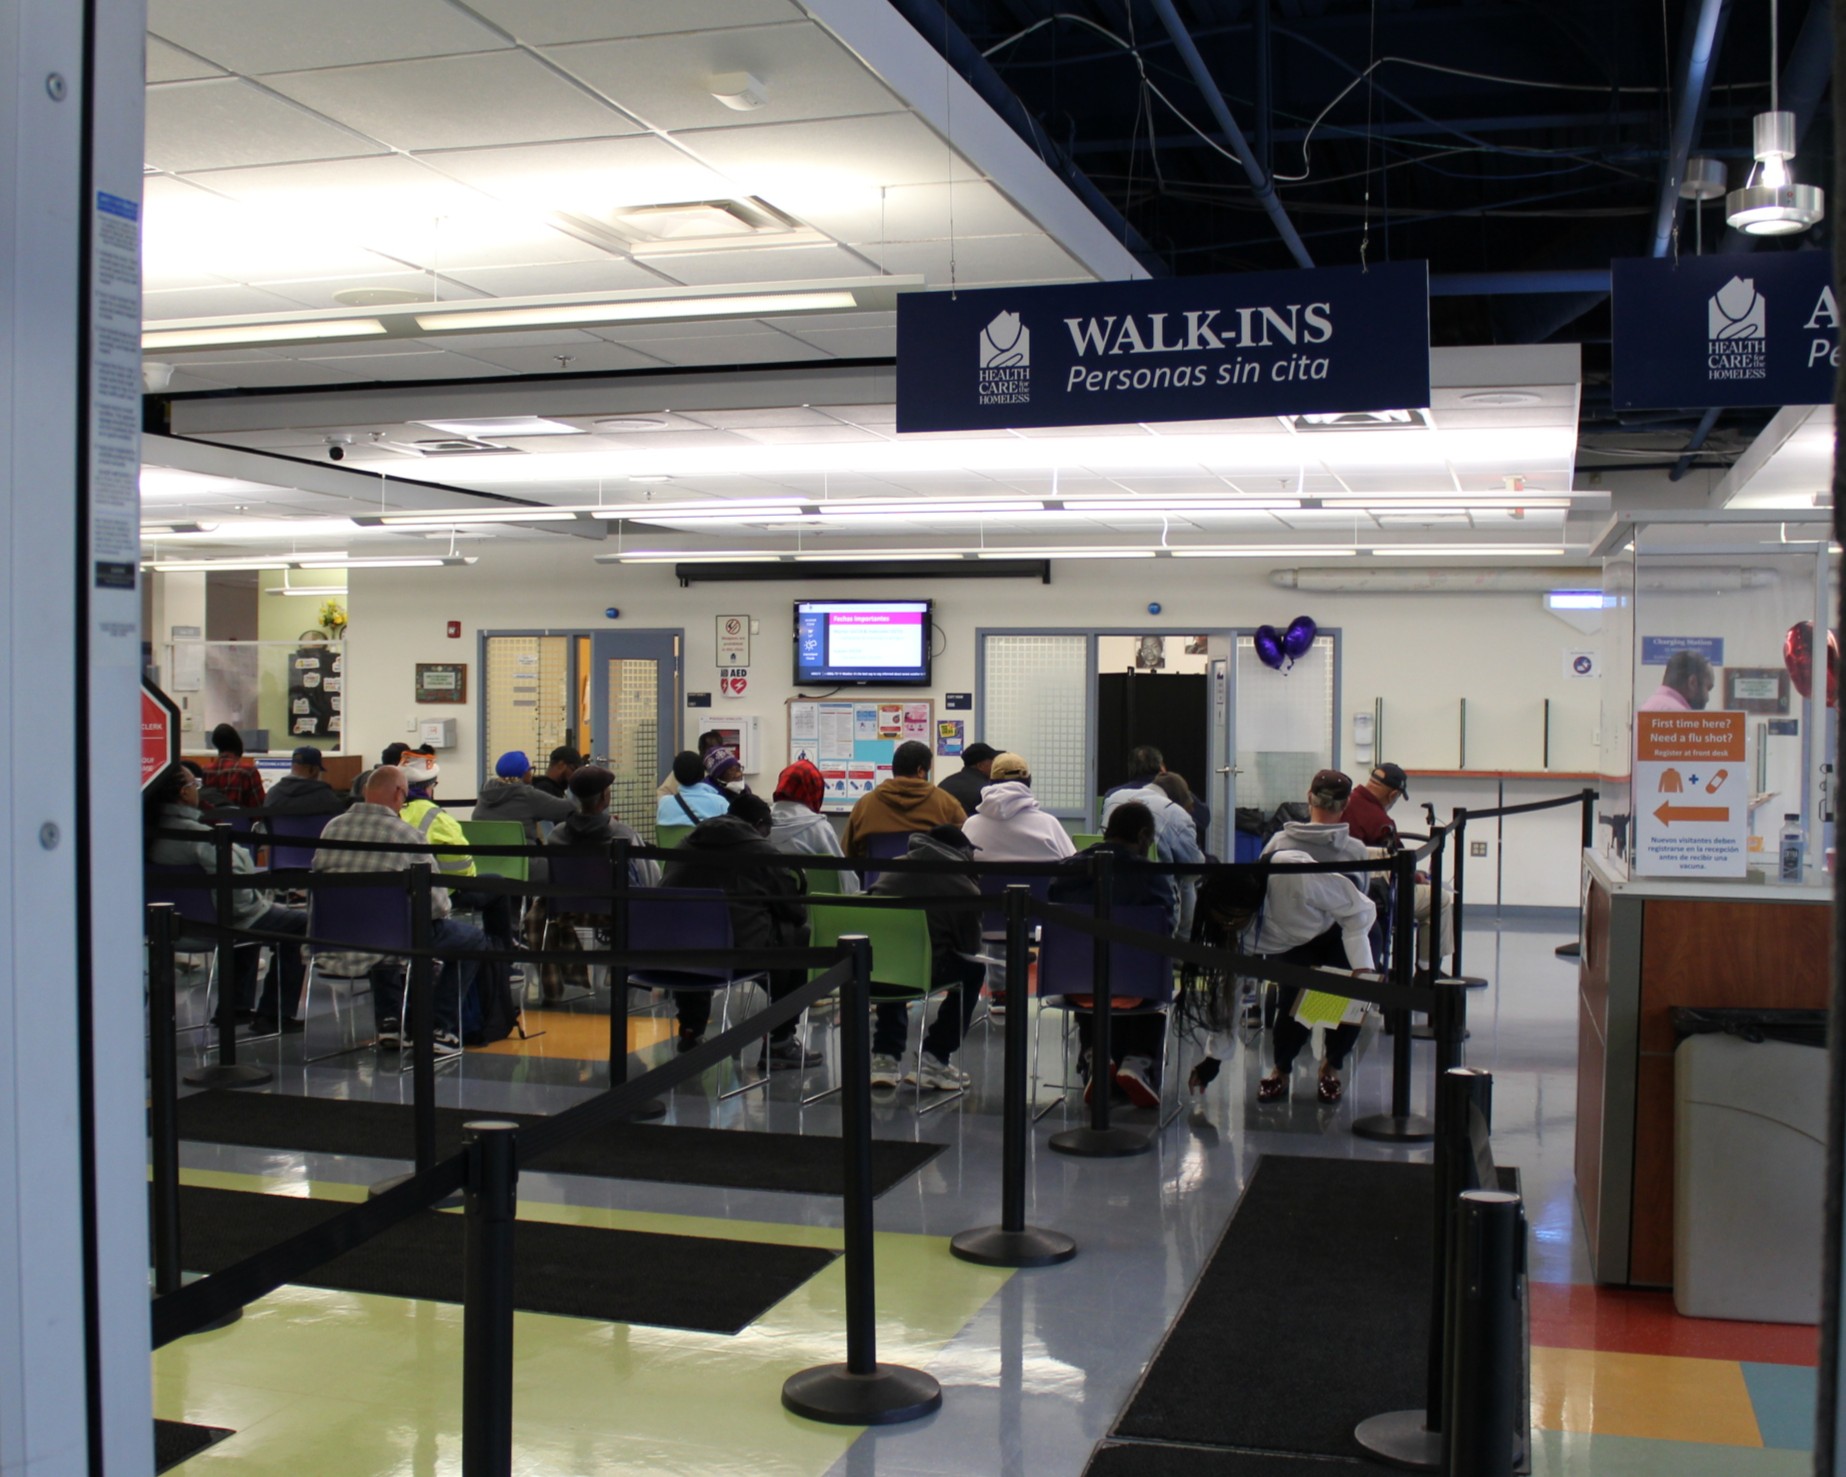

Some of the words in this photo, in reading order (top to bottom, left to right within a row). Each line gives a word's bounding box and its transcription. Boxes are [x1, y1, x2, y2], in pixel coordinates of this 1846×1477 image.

[1064, 303, 1333, 356] WALK-INS
[1708, 341, 1766, 354] HEALTH
[1708, 355, 1753, 368] CARE
[979, 368, 1030, 381] HEALTH
[1067, 365, 1206, 392] Personas
[1216, 357, 1260, 384] sin
[1271, 354, 1329, 381] cita
[1708, 369, 1766, 380] HOMELESS
[979, 381, 1018, 395] CARE
[979, 394, 1030, 405] HOMELESS
[1653, 638, 1685, 647] Charging
[1686, 638, 1713, 646] Station
[730, 669, 747, 677] AED
[1651, 719, 1673, 728] First
[1676, 719, 1700, 728] time
[1702, 719, 1731, 728] here?
[1650, 733, 1677, 742] Need
[1688, 732, 1702, 742] flu
[1704, 732, 1733, 742] shot?
[1654, 749, 1682, 757] Register
